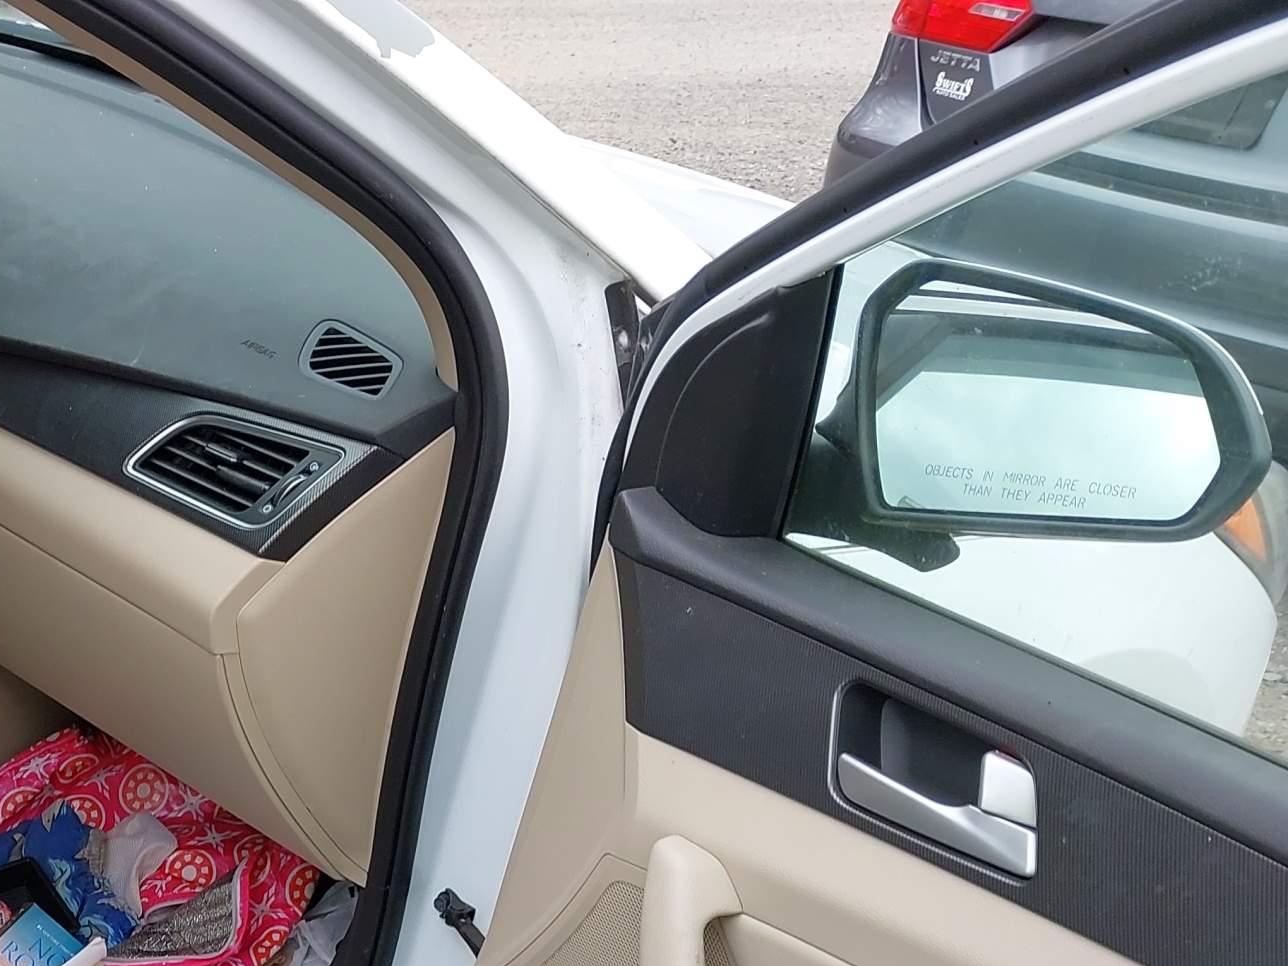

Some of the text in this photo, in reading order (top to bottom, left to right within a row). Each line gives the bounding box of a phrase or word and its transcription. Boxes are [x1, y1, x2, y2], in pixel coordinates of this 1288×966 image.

[930, 49, 981, 72] JETTA
[240, 339, 279, 360] AIRBAG
[924, 463, 1137, 500] OBJECTS IN MIRROR ARE CLOSER
[961, 483, 1087, 509] THAN THEY APPEAR
